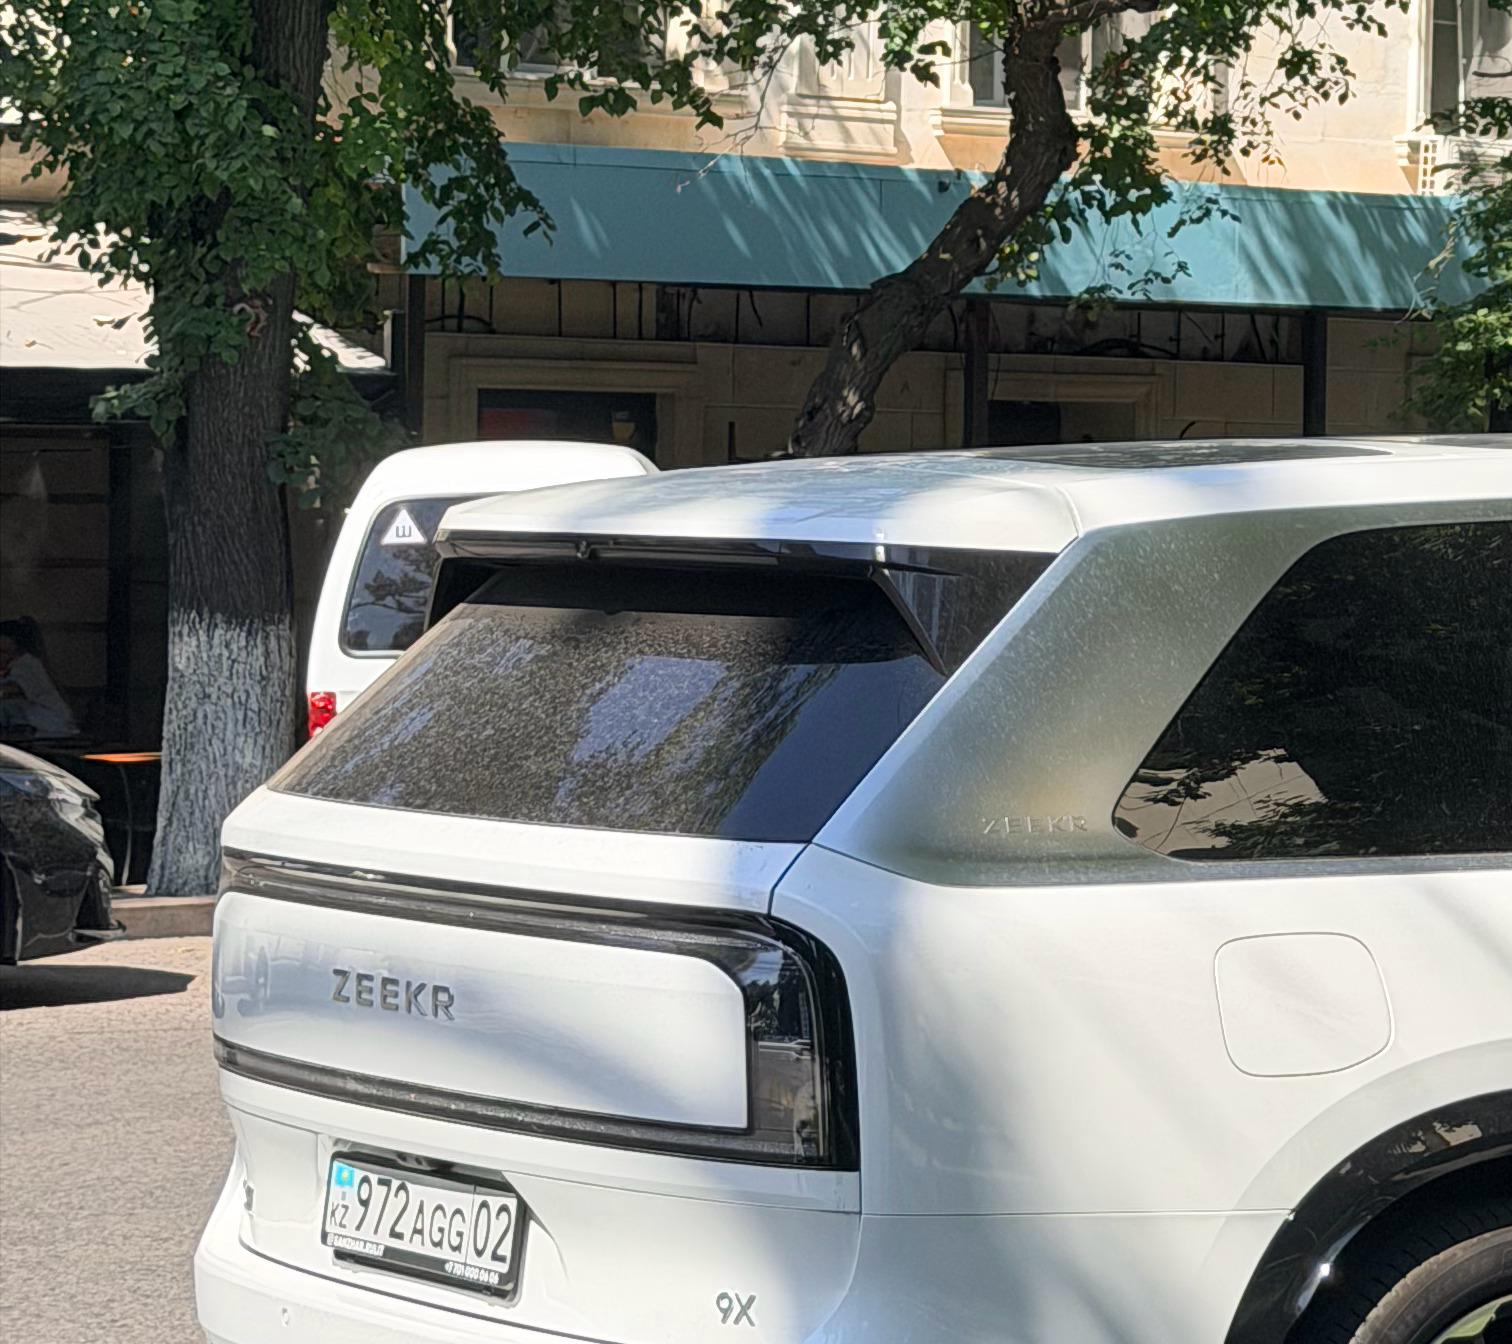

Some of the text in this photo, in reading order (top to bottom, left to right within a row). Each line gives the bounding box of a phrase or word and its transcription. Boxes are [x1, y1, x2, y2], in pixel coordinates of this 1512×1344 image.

[981, 815, 1088, 834] ZEEKR
[332, 968, 456, 1021] ZEEKR
[329, 1201, 350, 1230] KZ
[473, 1199, 512, 1264] 02
[715, 1291, 757, 1327] 9X
